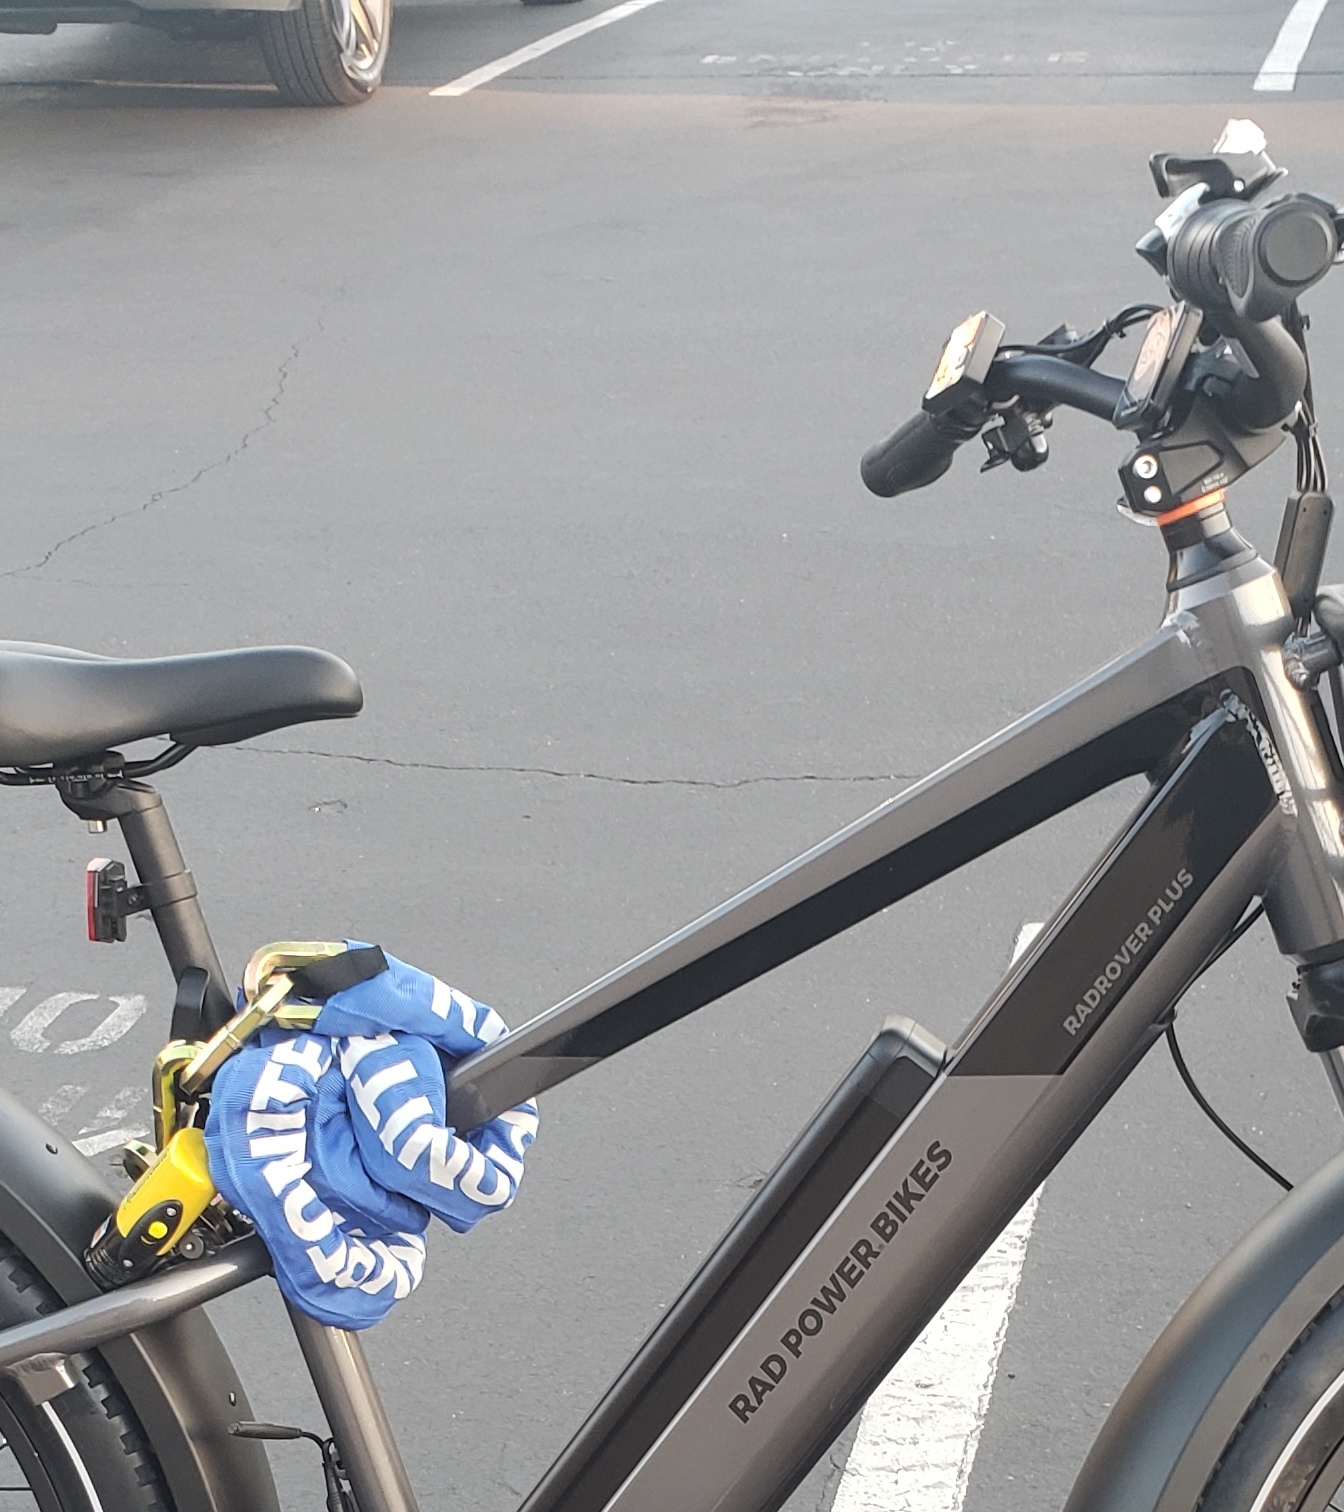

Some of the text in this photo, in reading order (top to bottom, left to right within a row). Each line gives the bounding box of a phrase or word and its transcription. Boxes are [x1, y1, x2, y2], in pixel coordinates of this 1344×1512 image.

[1062, 868, 1194, 1037] RADROVER PLUS
[728, 1140, 953, 1424] RAD POWER BIKES
